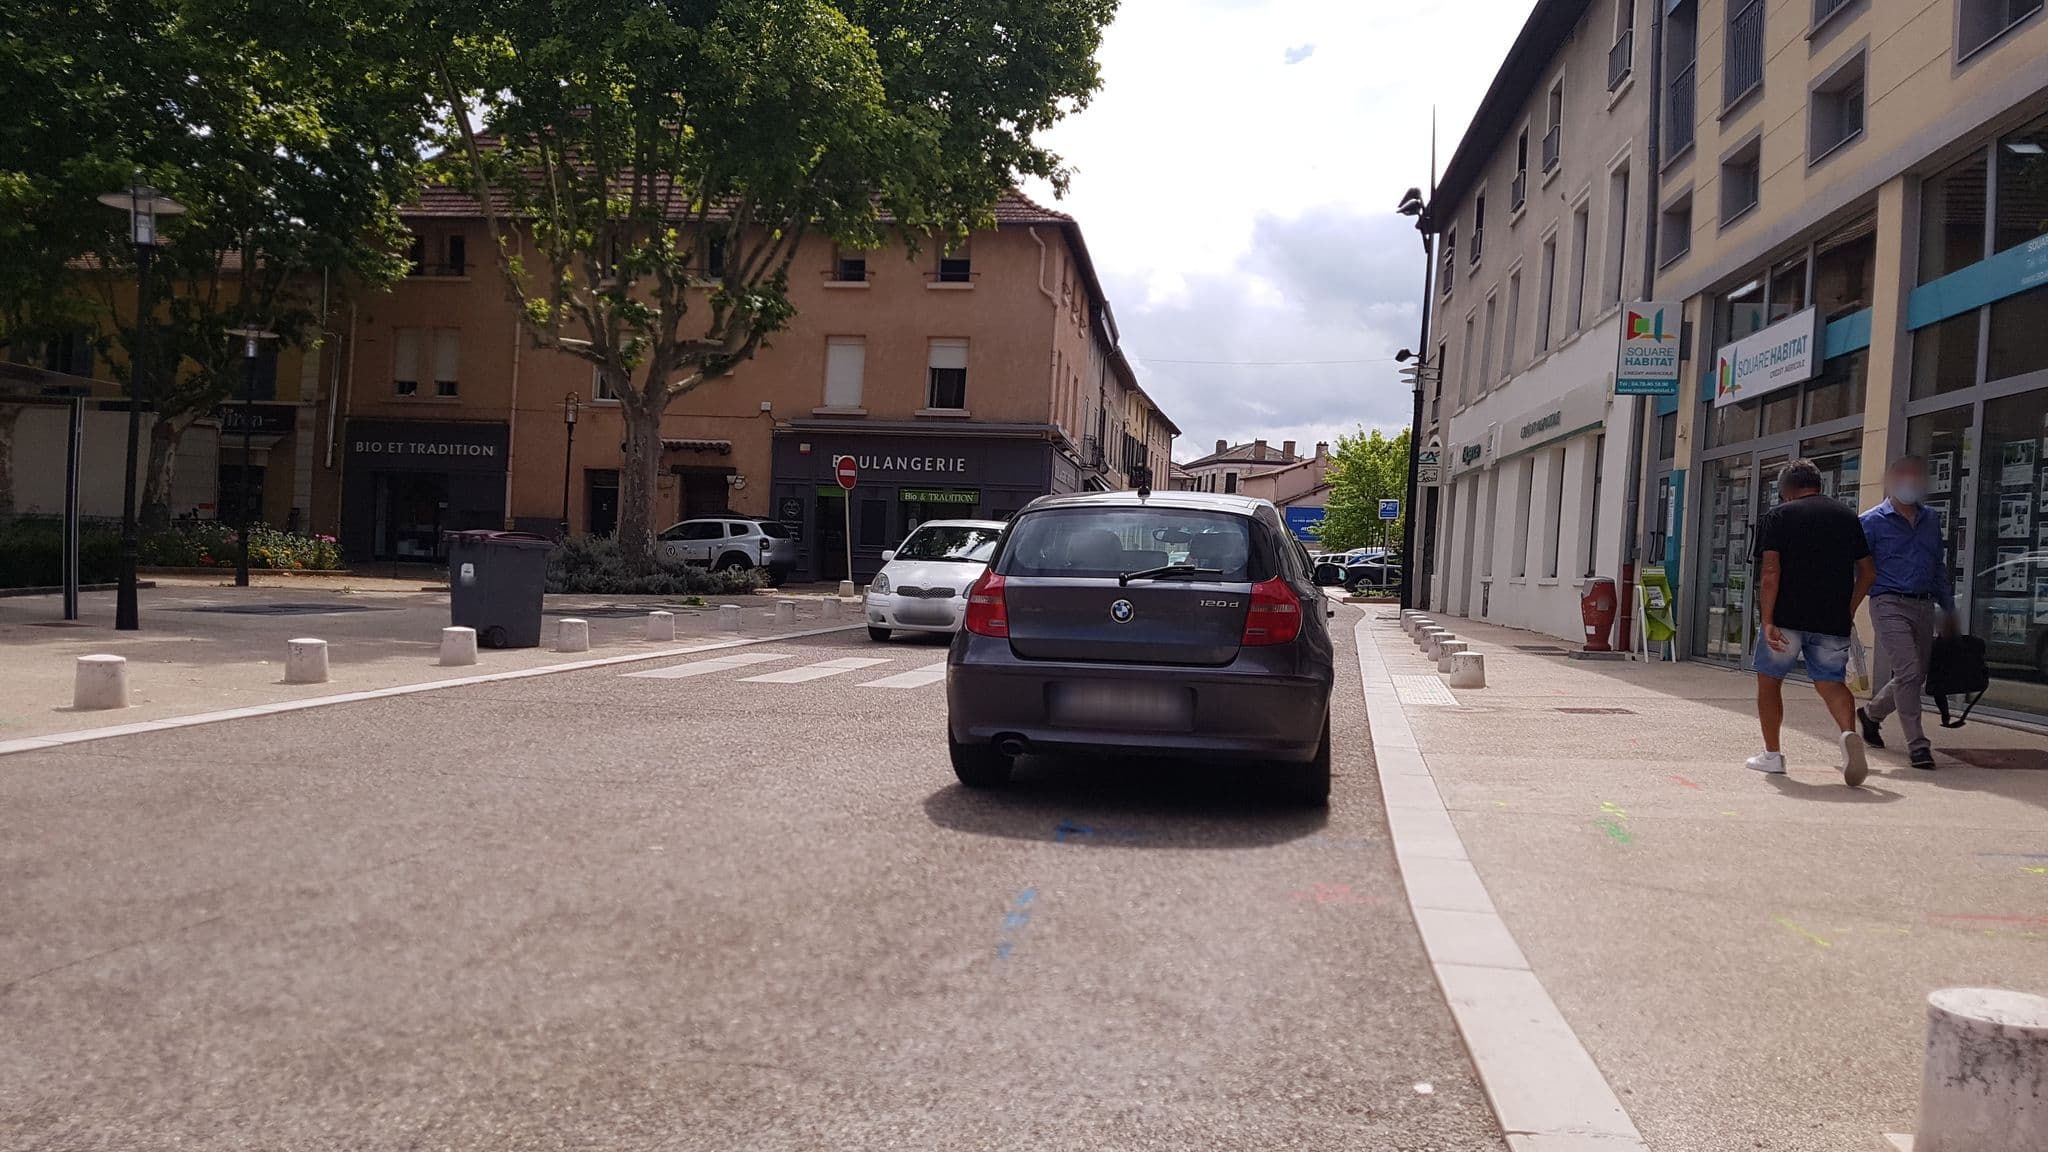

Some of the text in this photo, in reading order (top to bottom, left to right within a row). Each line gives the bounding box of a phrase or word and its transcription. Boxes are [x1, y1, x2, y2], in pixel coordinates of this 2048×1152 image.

[1626, 347, 1675, 357] SQUARE
[1625, 357, 1674, 367] HABITAT
[355, 441, 495, 457] BIO ET TRADITION
[832, 454, 966, 472] BULANGERIE
[904, 492, 975, 503] Bio & TRADITION
